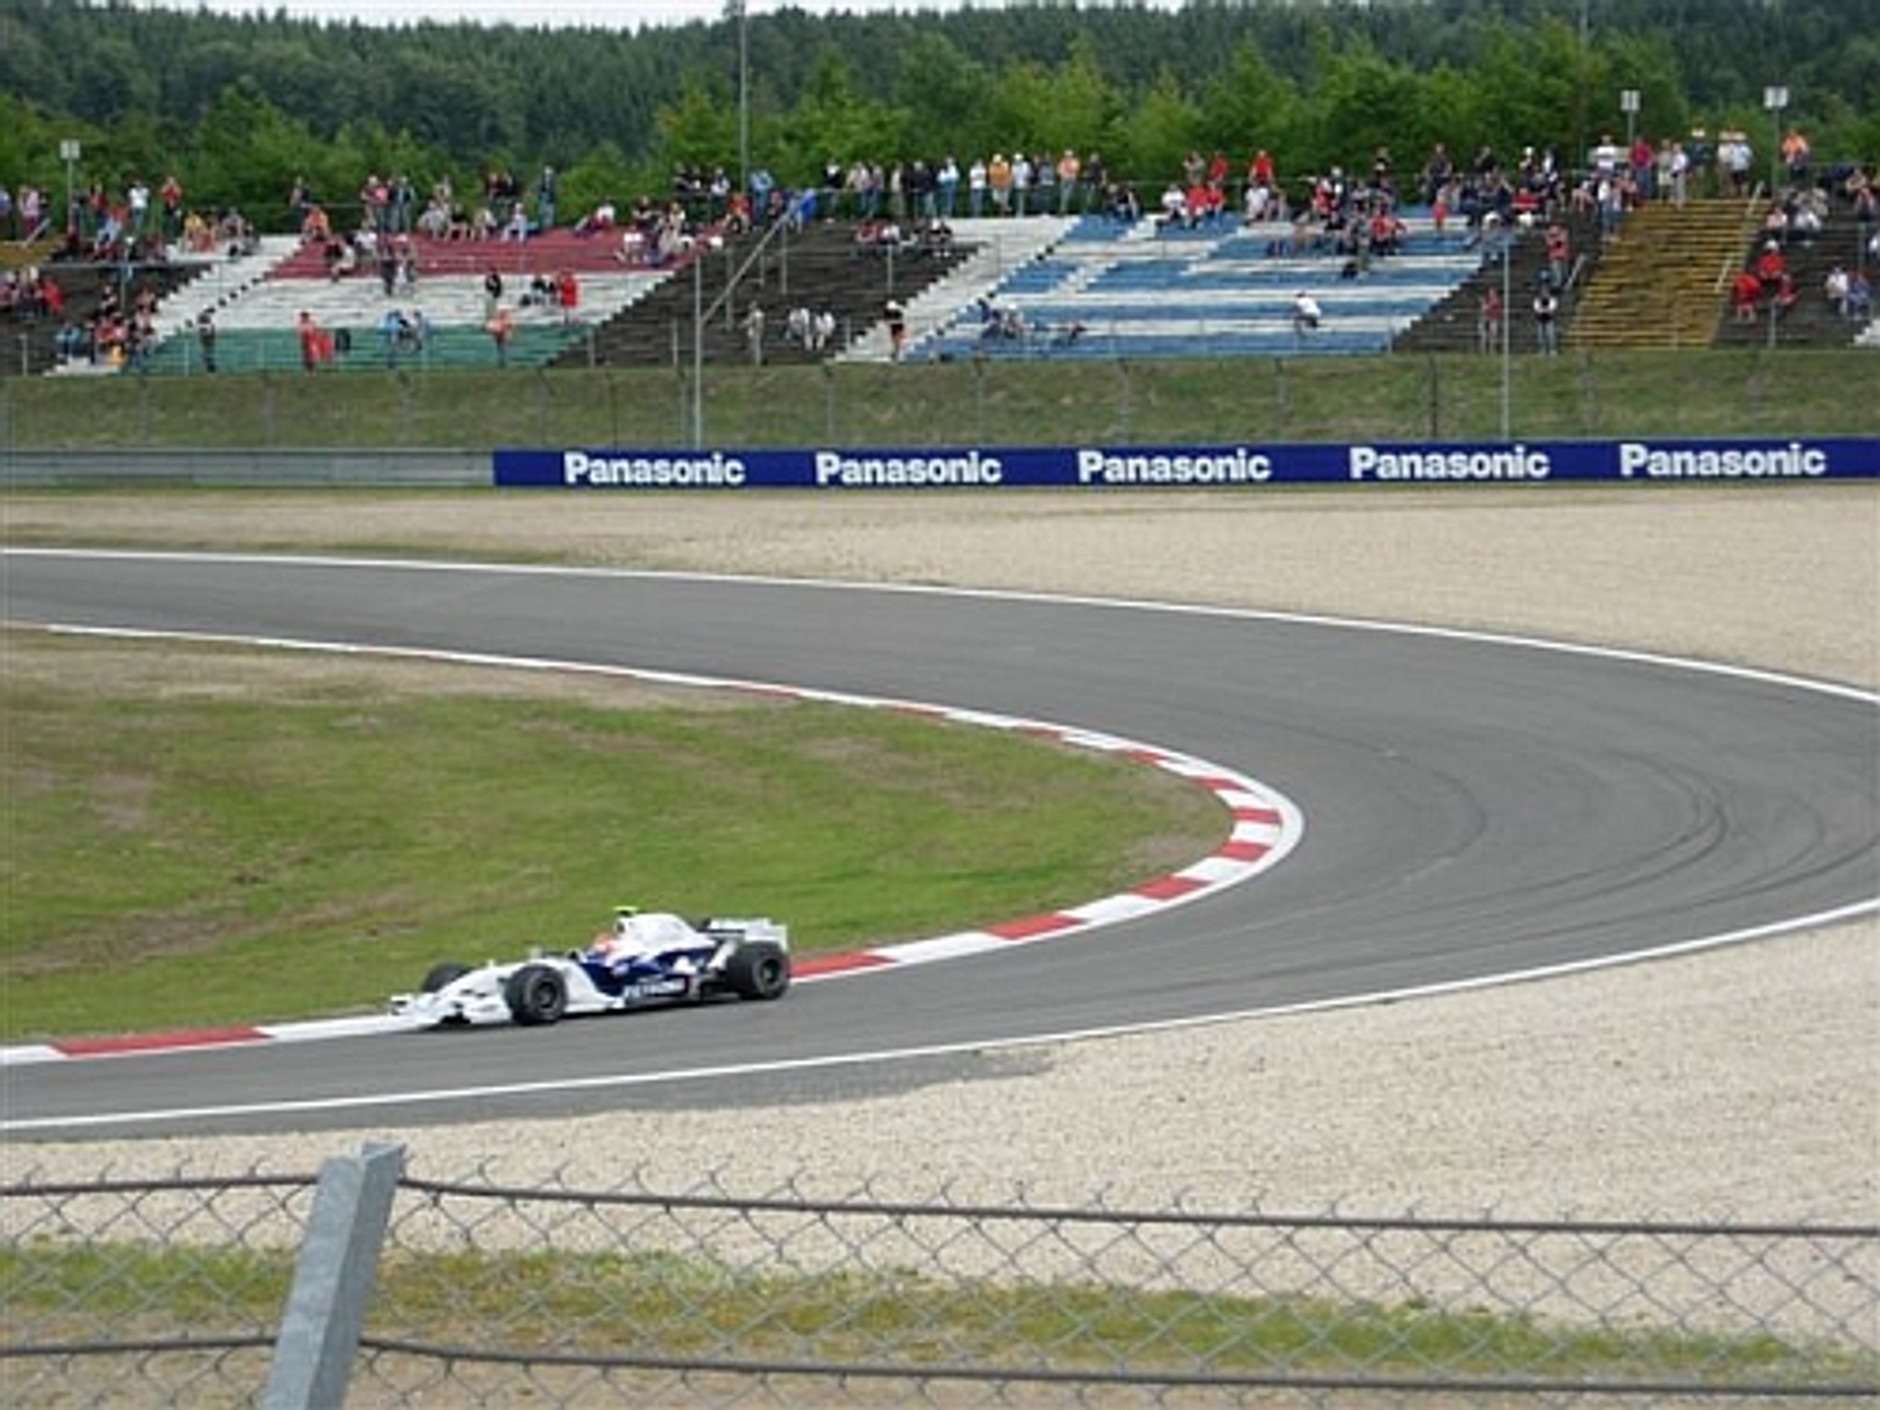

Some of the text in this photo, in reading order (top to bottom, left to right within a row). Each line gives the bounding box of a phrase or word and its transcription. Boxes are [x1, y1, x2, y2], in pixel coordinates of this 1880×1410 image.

[564, 443, 1825, 484] Panasonic Panasonic Panasonic Panasonic Panasonic
